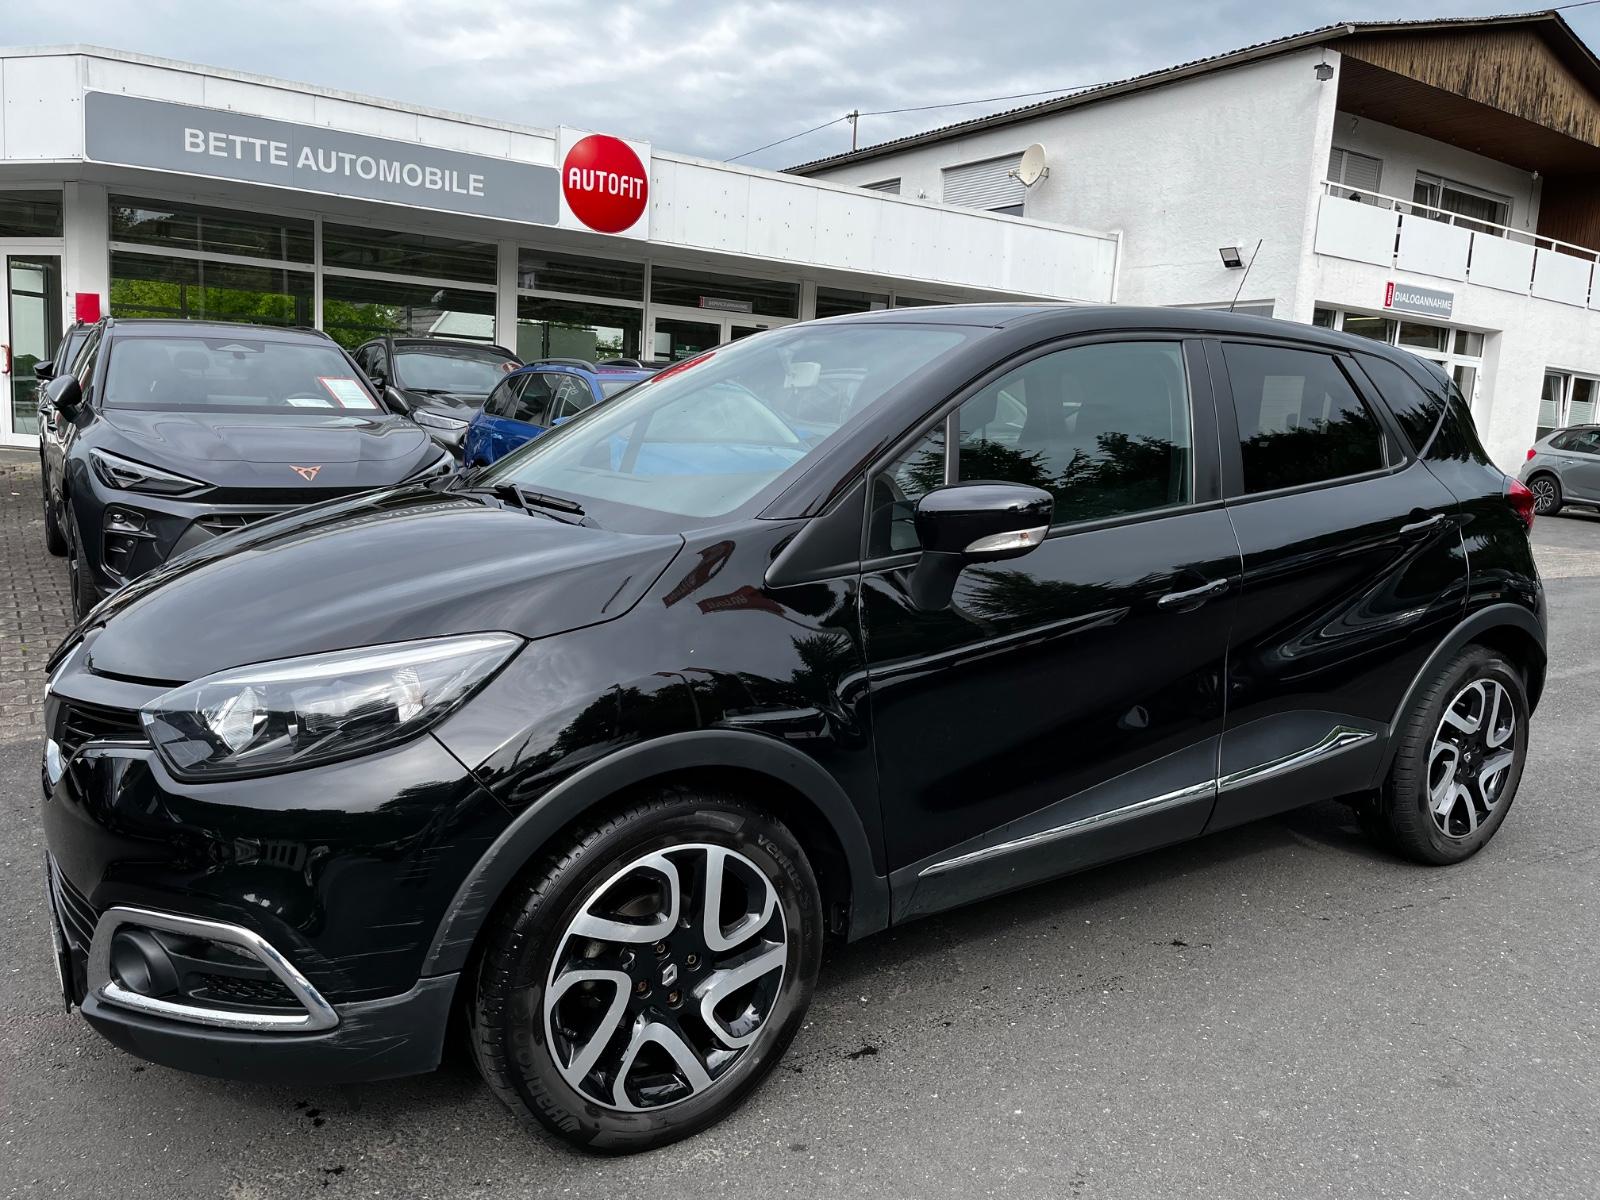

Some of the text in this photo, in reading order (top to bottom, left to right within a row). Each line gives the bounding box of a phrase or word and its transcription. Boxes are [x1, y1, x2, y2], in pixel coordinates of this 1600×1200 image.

[184, 127, 485, 197] BETTE AUTOMOBILE
[568, 167, 644, 200] AUTOFIT
[1395, 291, 1452, 310] DIALOGANNAHME
